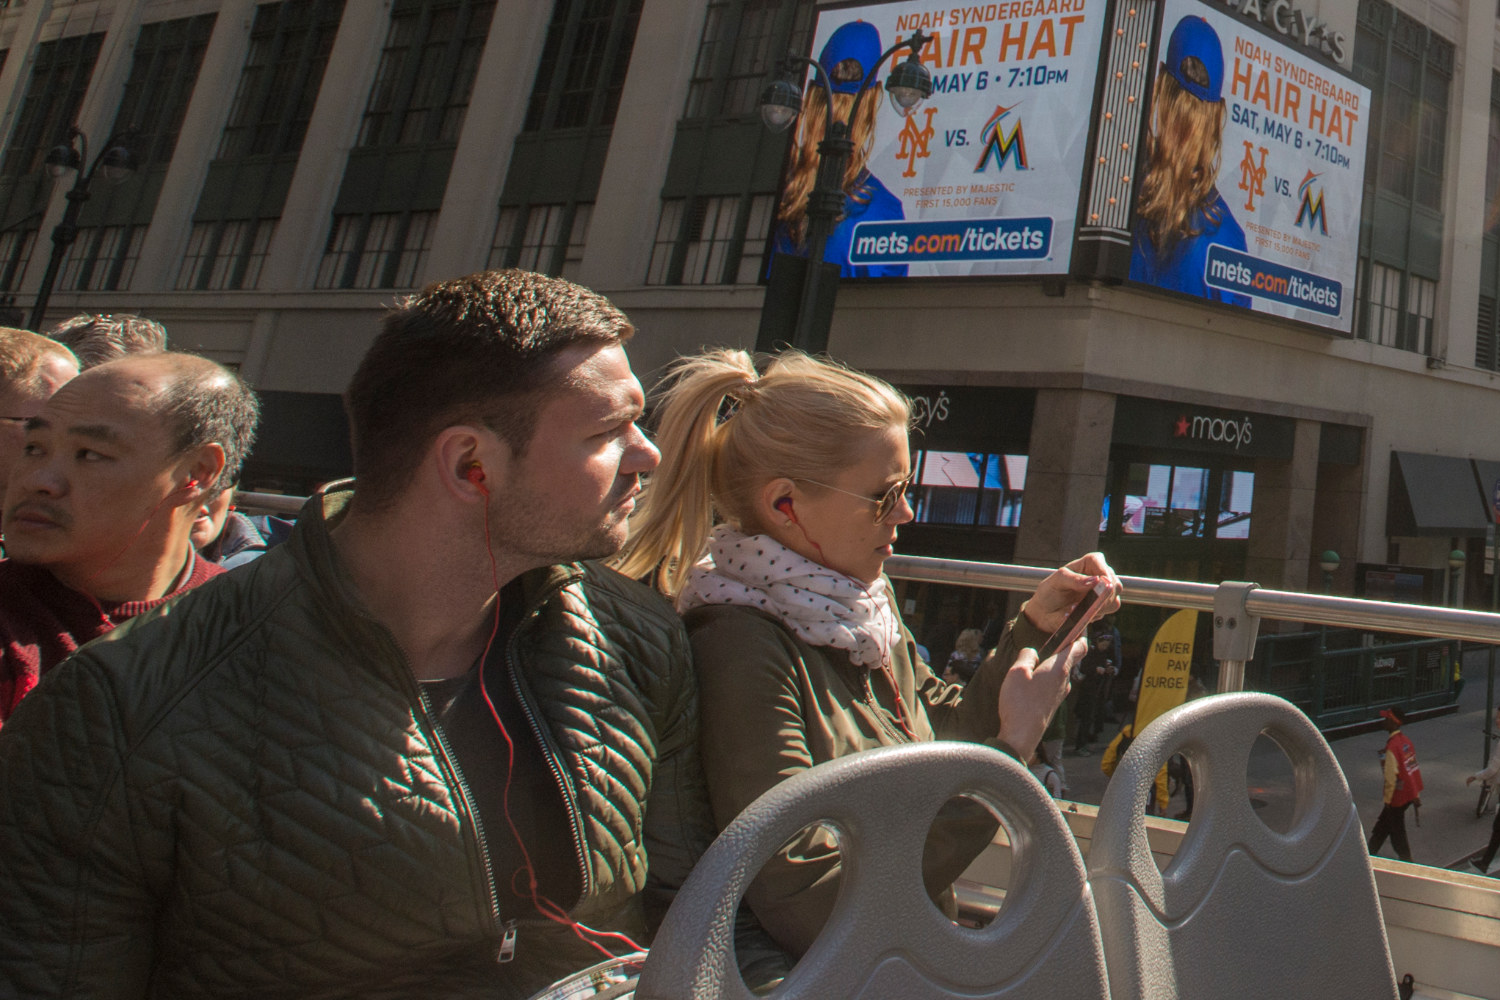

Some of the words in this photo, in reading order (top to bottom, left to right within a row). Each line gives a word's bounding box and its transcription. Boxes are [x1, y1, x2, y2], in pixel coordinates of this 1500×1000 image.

[896, 10, 945, 32] NOAH
[998, 15, 1085, 63] HAT
[931, 72, 973, 94] MAY
[976, 70, 989, 91] 6
[1008, 65, 1069, 88] 7:10PM
[1234, 36, 1272, 68] NOAH
[1274, 56, 1360, 111] SYNDERGAARD
[1231, 57, 1302, 124] HAIR
[1308, 93, 1359, 147] HAT
[945, 129, 970, 147] VS.
[1231, 103, 1260, 135] SAT,
[1263, 116, 1293, 145] MAY
[1294, 130, 1303, 150] 6
[1314, 139, 1351, 169] 7:10PM
[903, 186, 954, 197] PRESENTED
[956, 184, 969, 195] BY
[970, 182, 1016, 194] MAJESTIC
[1274, 176, 1292, 198] VS.
[915, 198, 940, 209] FIRST
[974, 196, 999, 206] FANS
[856, 225, 1044, 255] mets.com/tickets
[1245, 221, 1282, 240] PRESENTED
[1283, 232, 1291, 243] BY
[1292, 236, 1321, 252] MAJESTIC
[1255, 236, 1273, 249] FIRST
[1210, 258, 1339, 309] mets.com/tickets
[1191, 415, 1253, 450] macy's
[1155, 641, 1191, 654] NEVER
[1166, 659, 1189, 672] PAY
[1144, 676, 1185, 689] SURGE.
